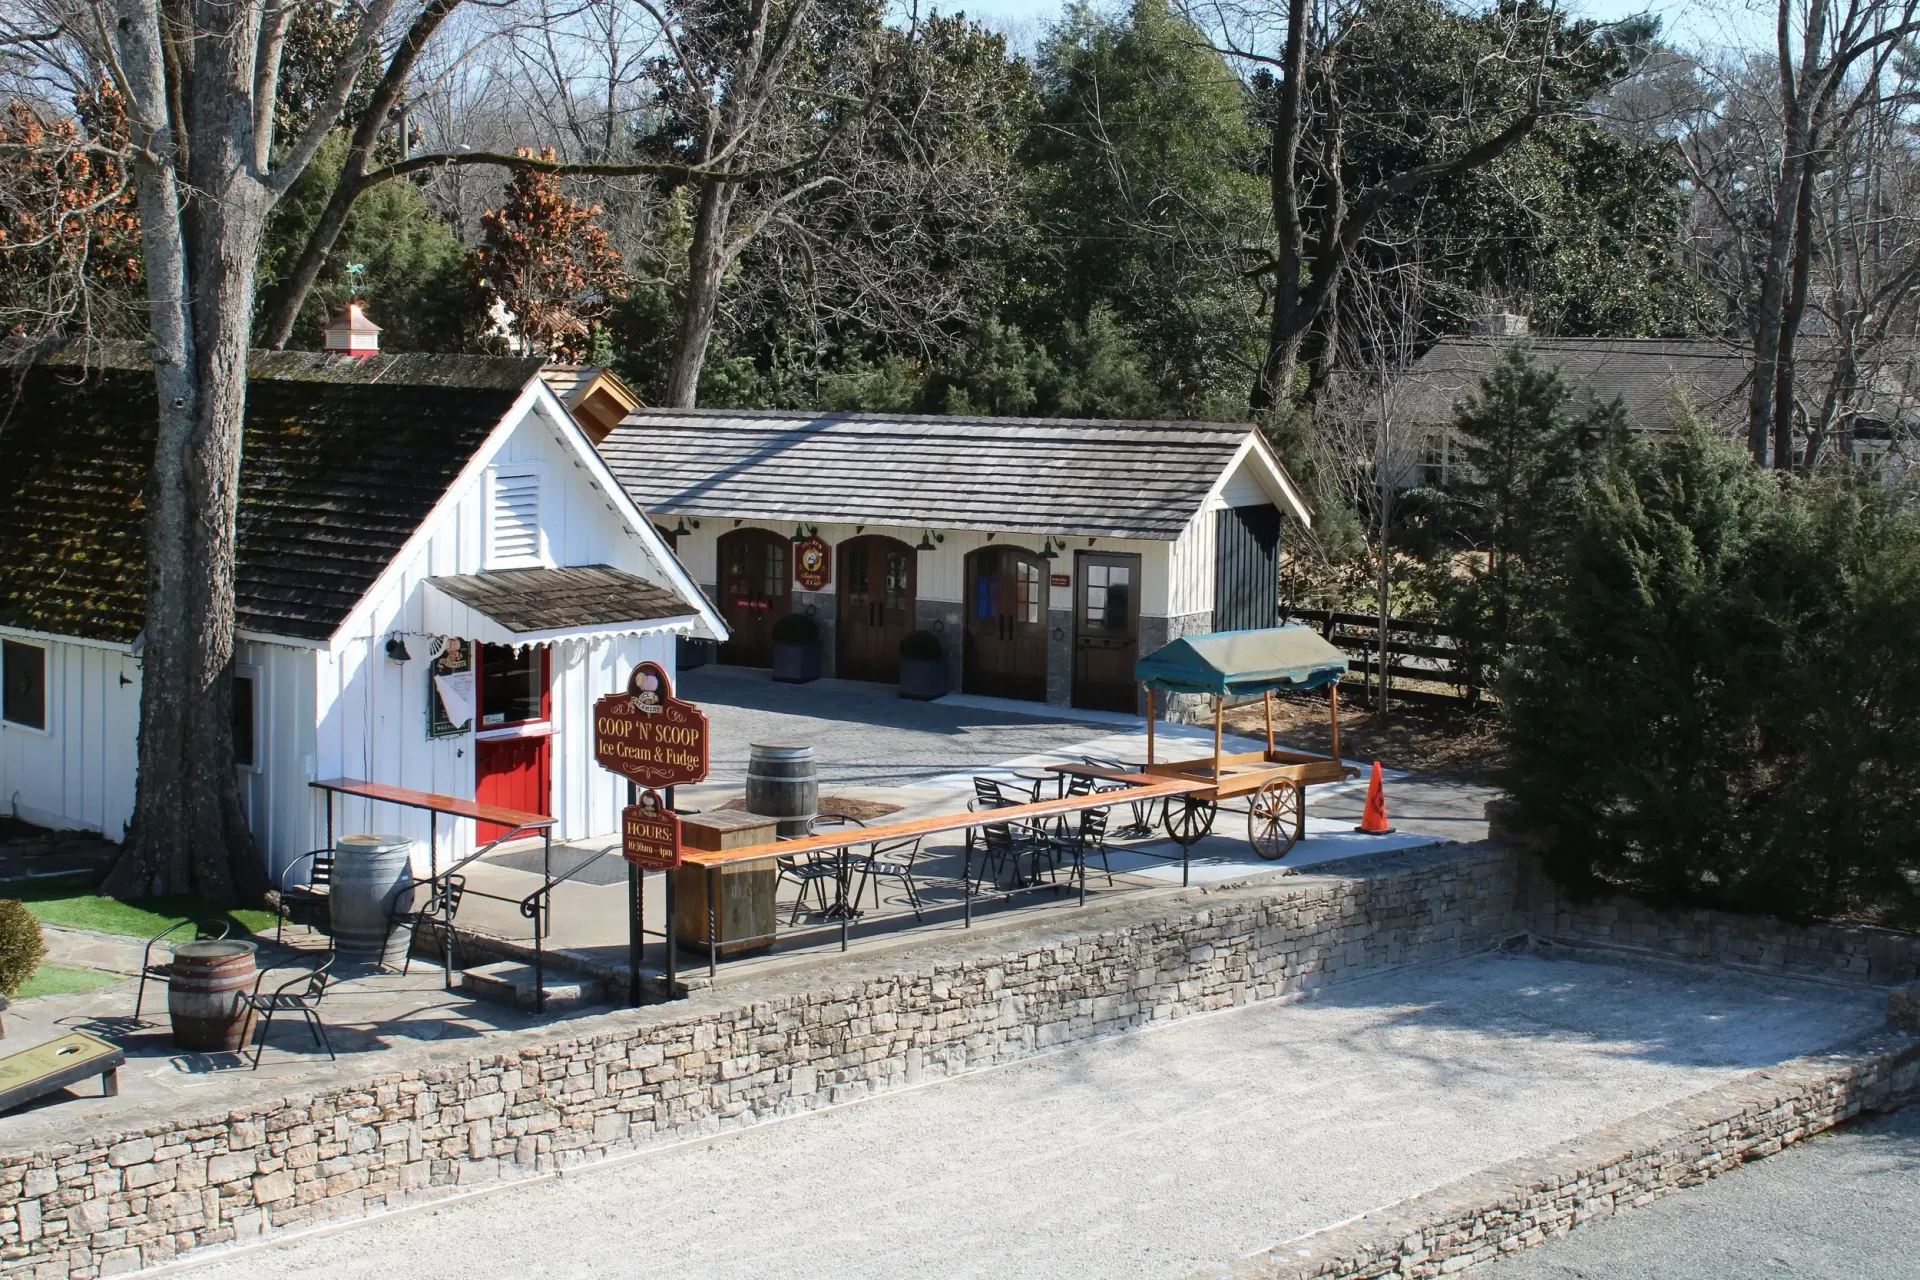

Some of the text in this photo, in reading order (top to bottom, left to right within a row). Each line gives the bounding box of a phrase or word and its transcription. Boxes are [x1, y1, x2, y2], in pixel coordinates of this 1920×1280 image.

[598, 717, 632, 737] COOP
[655, 723, 699, 747] SCOOP
[599, 738, 699, 771] Ice Cream & Fudge
[628, 822, 672, 841] HOURS:
